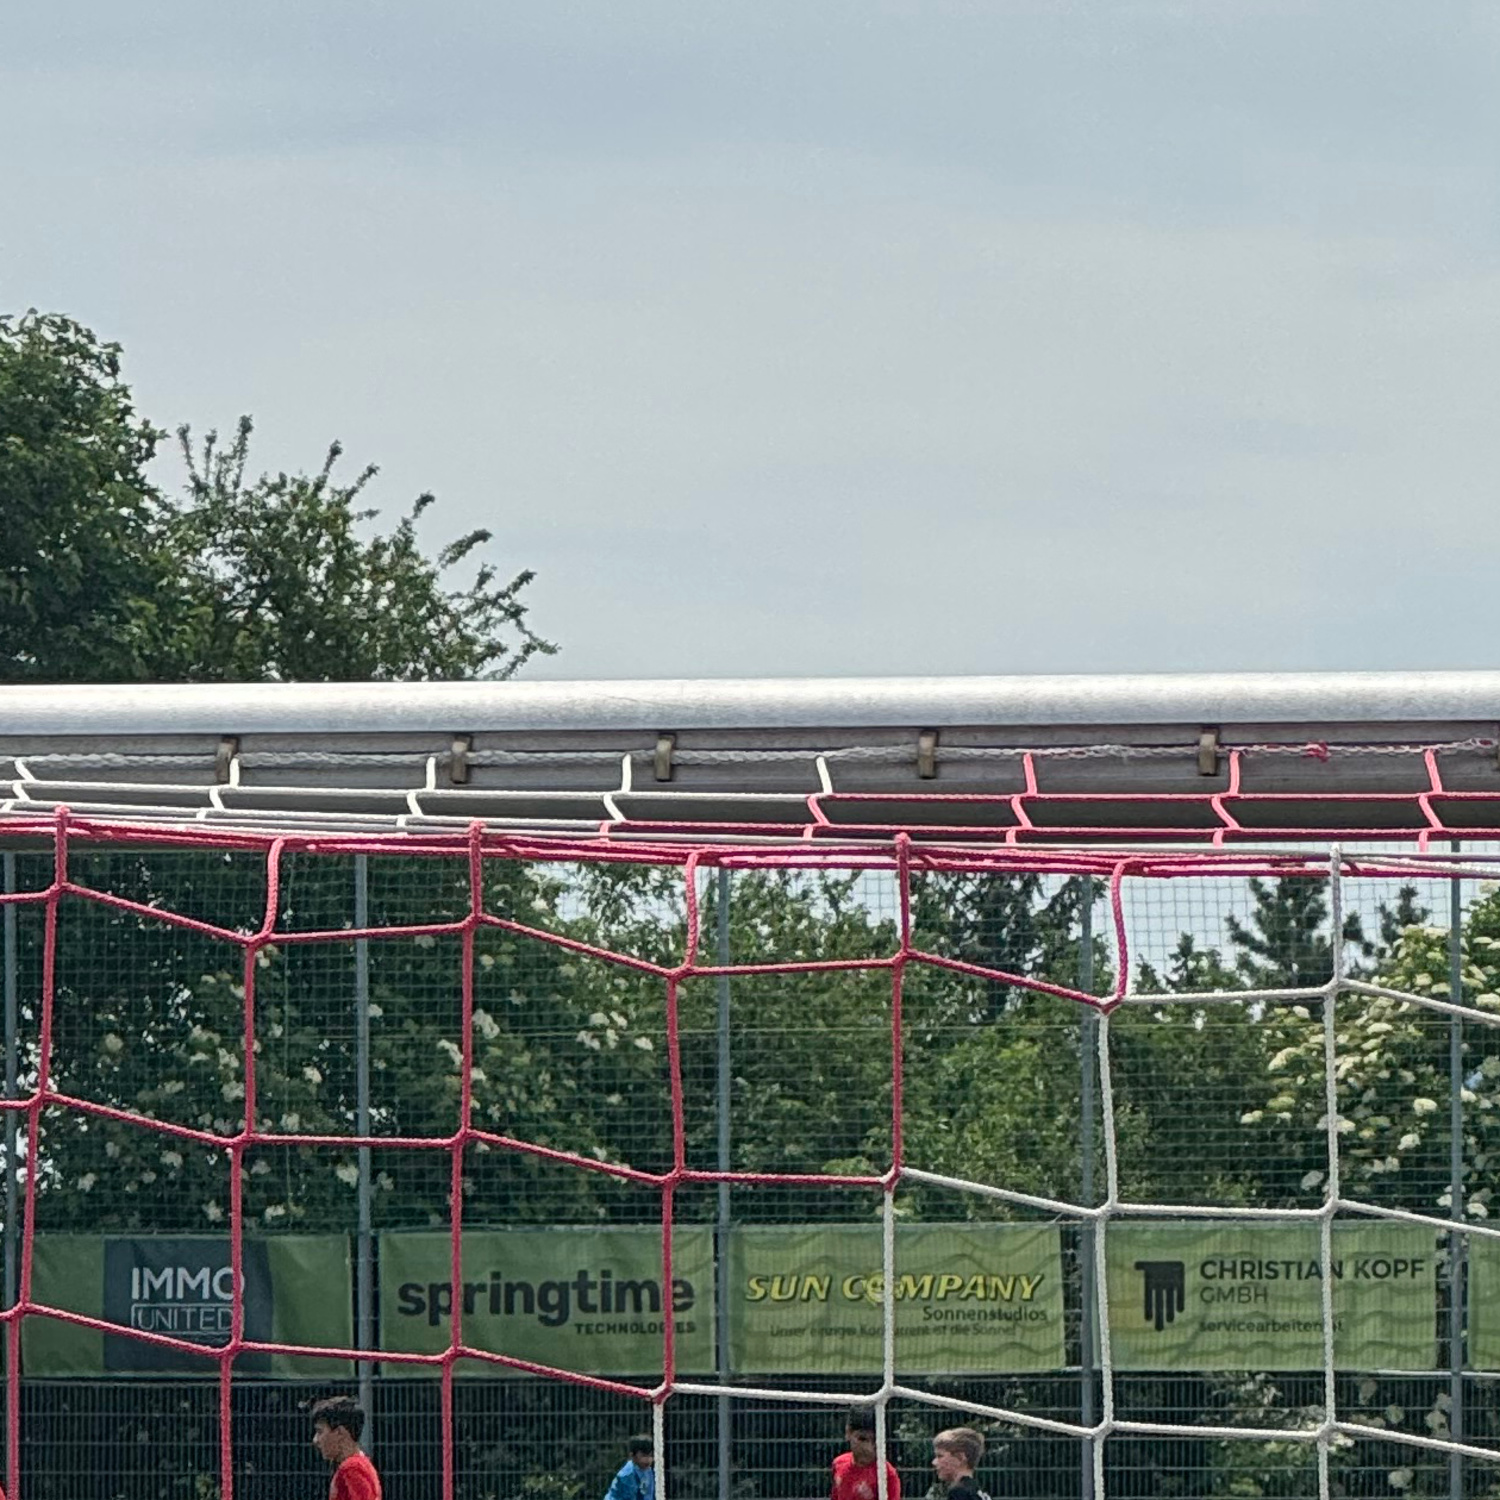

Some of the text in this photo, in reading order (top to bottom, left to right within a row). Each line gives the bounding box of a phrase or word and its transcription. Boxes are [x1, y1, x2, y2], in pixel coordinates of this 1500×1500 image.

[1200, 1258, 1424, 1280] CHRISTIAN KOPF
[131, 1266, 245, 1300] IMMO
[746, 1275, 831, 1301] SUN
[397, 1270, 695, 1327] springtime
[1200, 1286, 1268, 1304] GMBH
[138, 1307, 237, 1331] UNITED
[923, 1305, 1048, 1321] Sonnenstudios
[575, 1321, 696, 1335] TECHNOLOES
